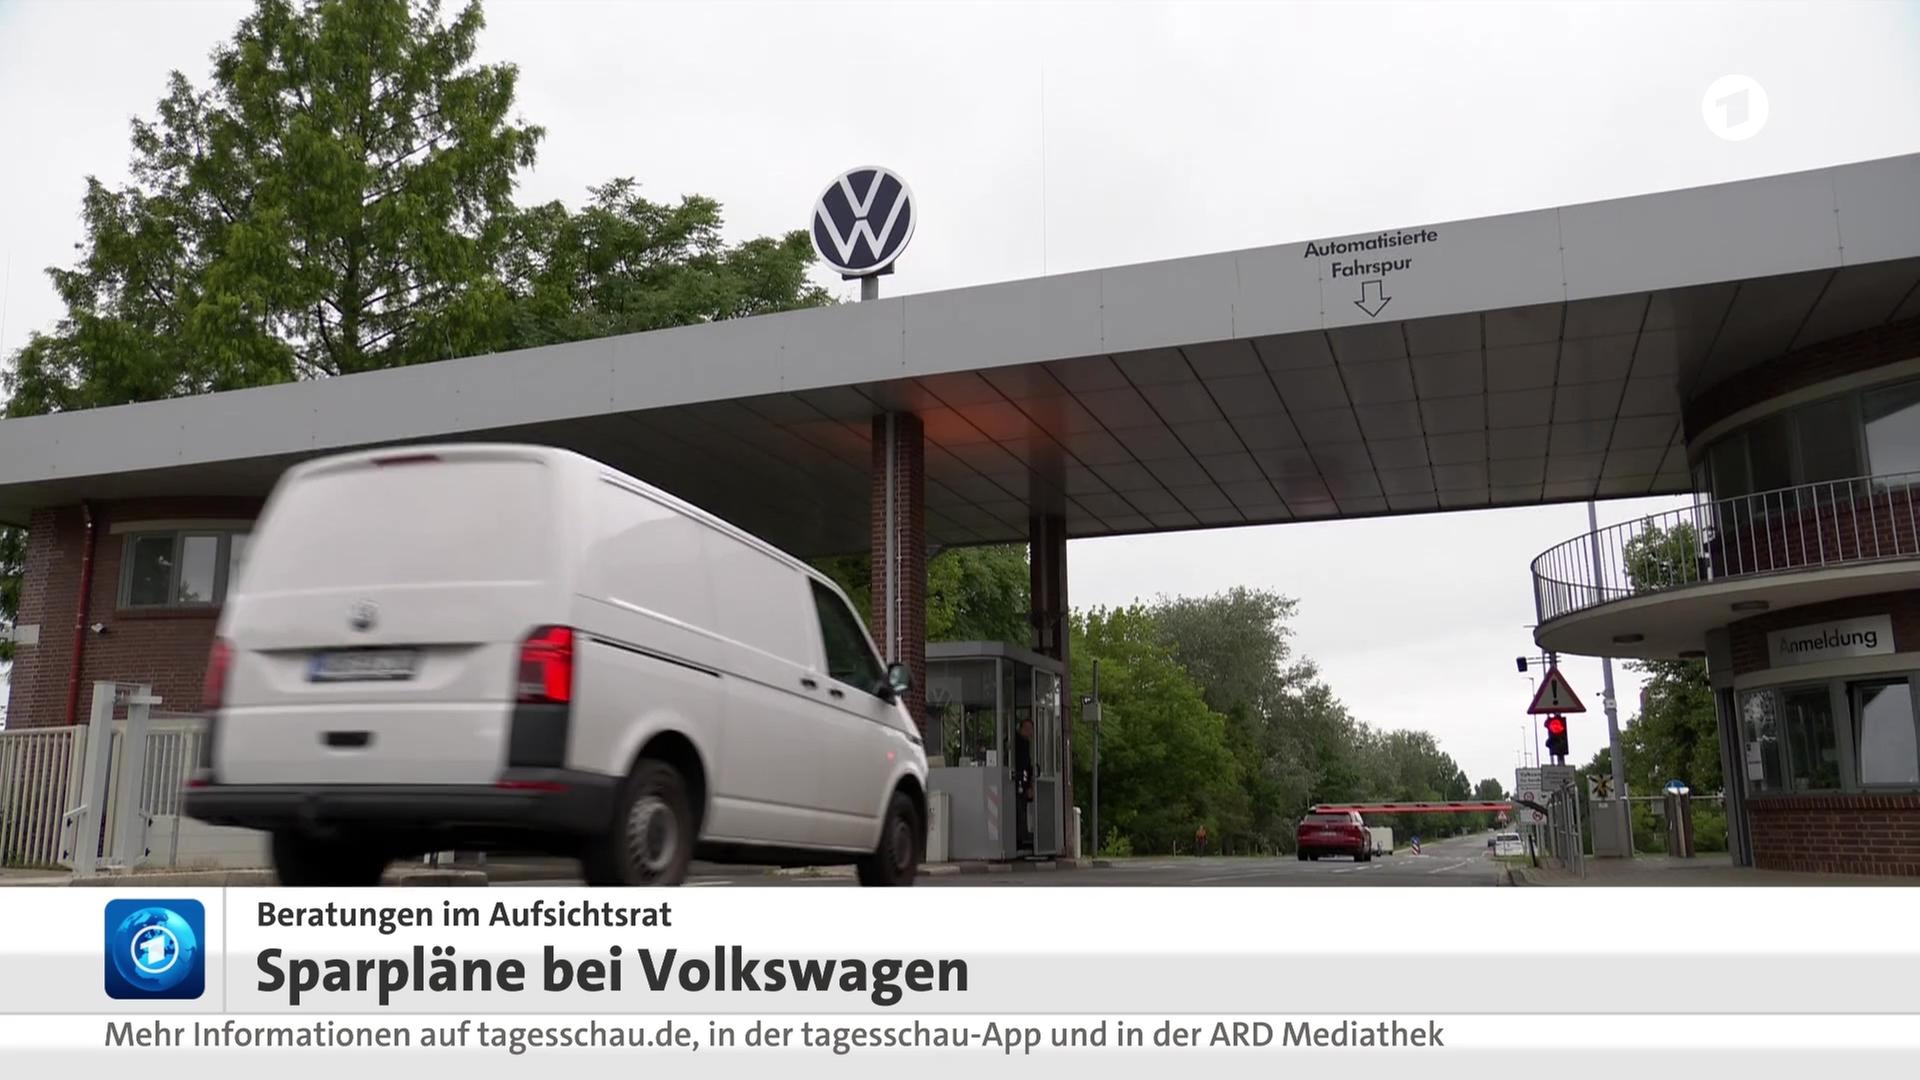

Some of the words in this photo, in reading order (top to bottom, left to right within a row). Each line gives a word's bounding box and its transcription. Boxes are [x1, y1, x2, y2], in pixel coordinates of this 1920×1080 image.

[1304, 229, 1438, 259] Automatisierte
[1331, 257, 1413, 279] Fahrspur
[1778, 628, 1878, 655] Anmeldung
